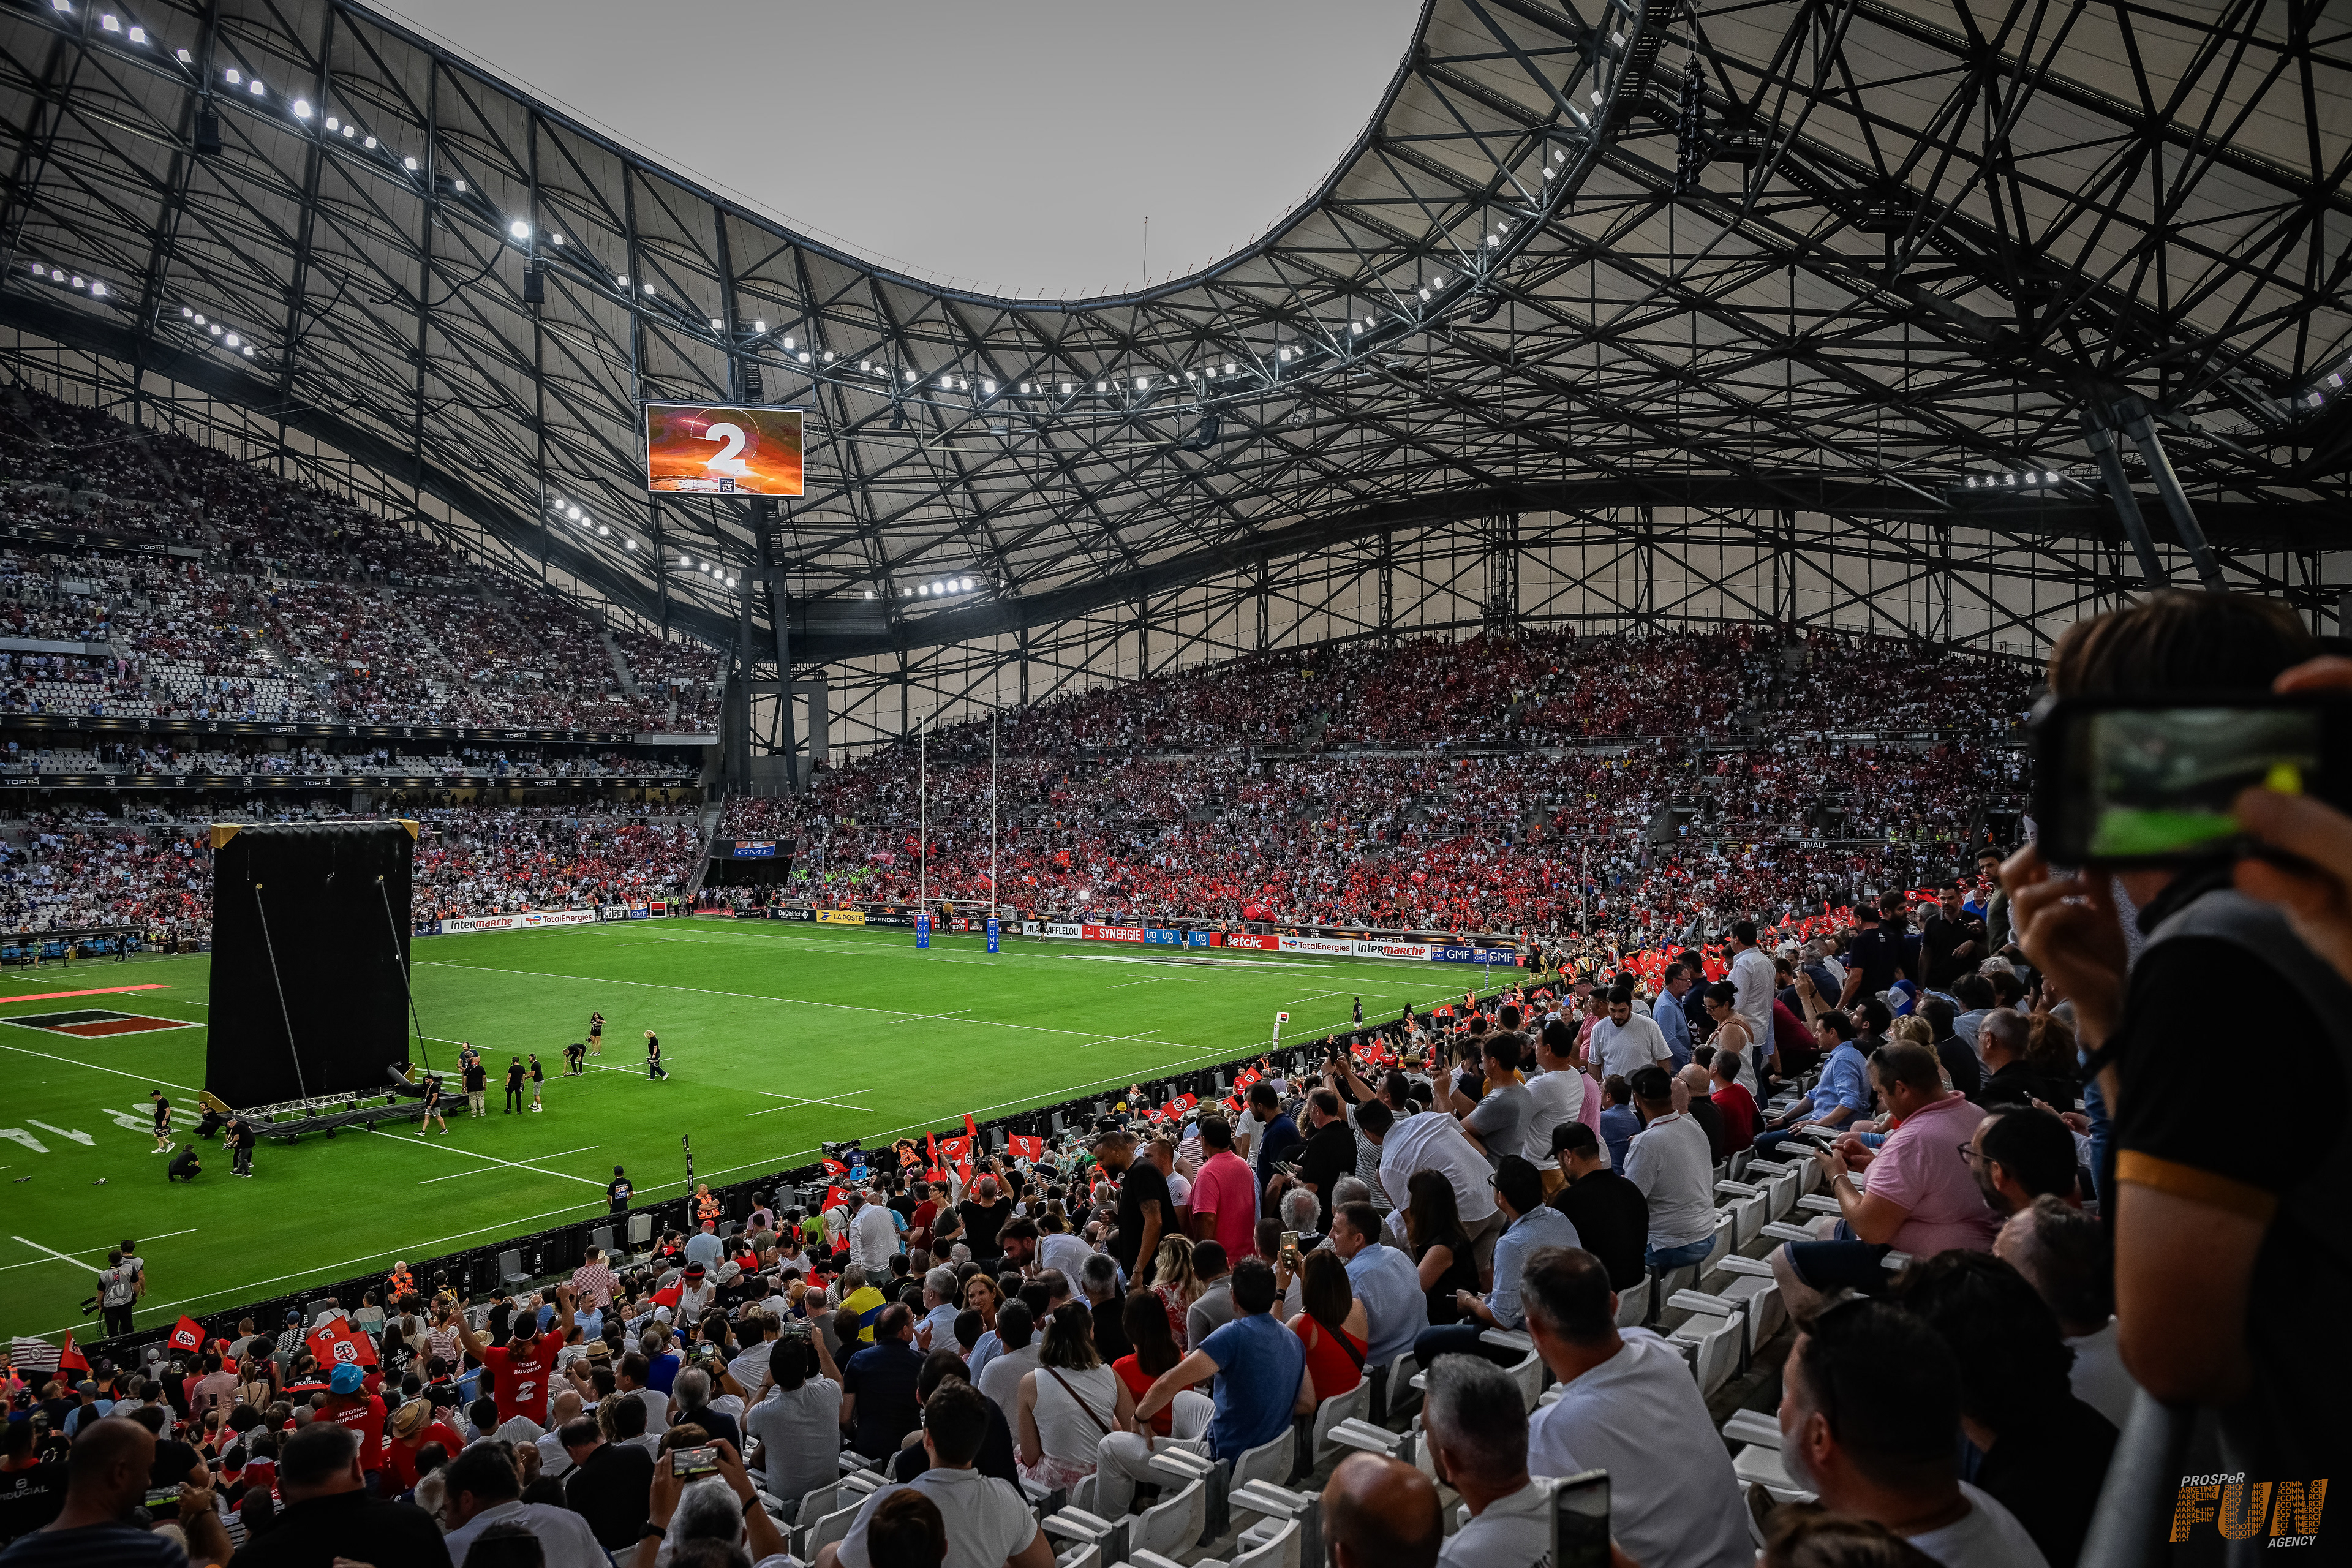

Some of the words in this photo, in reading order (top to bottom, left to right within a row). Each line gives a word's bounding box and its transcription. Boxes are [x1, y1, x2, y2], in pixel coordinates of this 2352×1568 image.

[706, 423, 746, 473] 2
[543, 912, 592, 923] TotalEnergies
[1048, 925, 1079, 936] AFFLELOU
[1099, 927, 1142, 941] SYNERGIE
[1227, 935, 1262, 948] Betclic
[1299, 941, 1350, 952] TotalEnergies
[1447, 949, 1470, 959] GMF
[1490, 952, 1513, 962] GMF
[391, 1351, 410, 1362] FIDUCIAL
[396, 1356, 407, 1365] ANNA
[516, 1381, 537, 1402] 2
